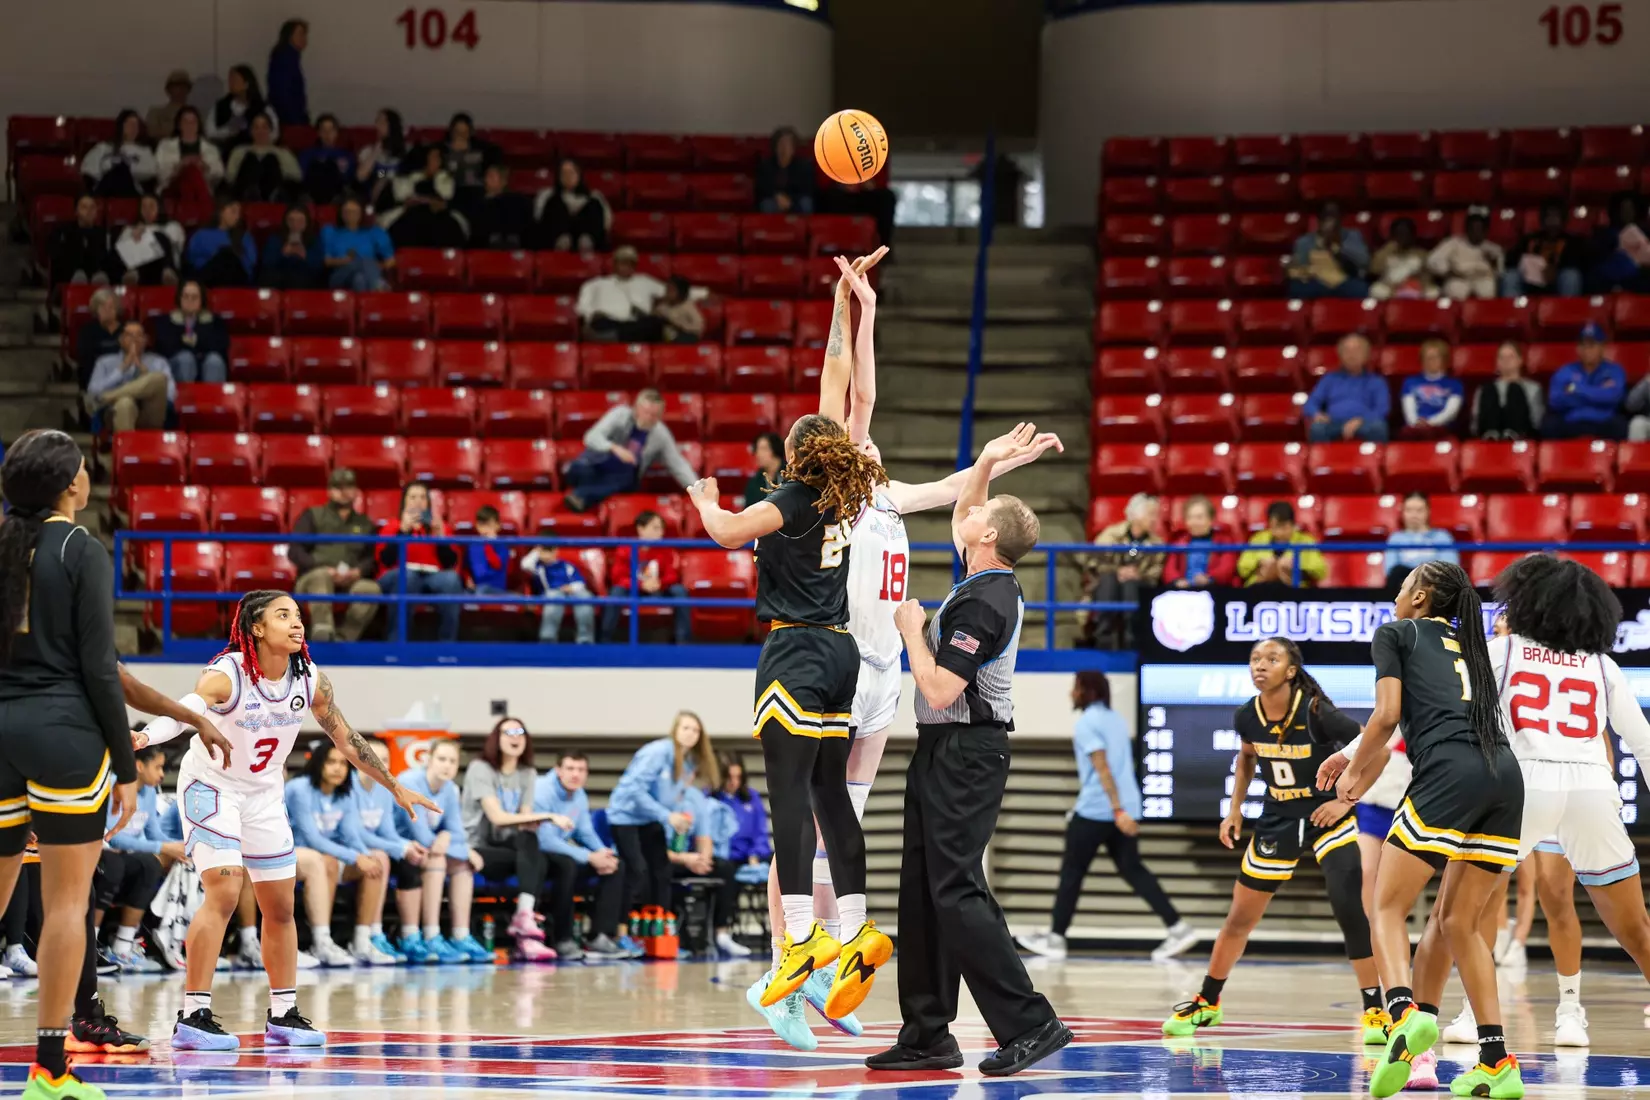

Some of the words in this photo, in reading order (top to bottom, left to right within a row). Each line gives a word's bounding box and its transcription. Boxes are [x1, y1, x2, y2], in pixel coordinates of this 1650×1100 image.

[394, 7, 482, 51] 104
[1538, 4, 1624, 48] 105
[850, 121, 874, 172] Wilson
[879, 550, 907, 601] 18
[1523, 646, 1588, 669] BRADLEY
[1510, 671, 1598, 739] 23
[249, 737, 279, 773] 3
[1269, 760, 1296, 787] 0
